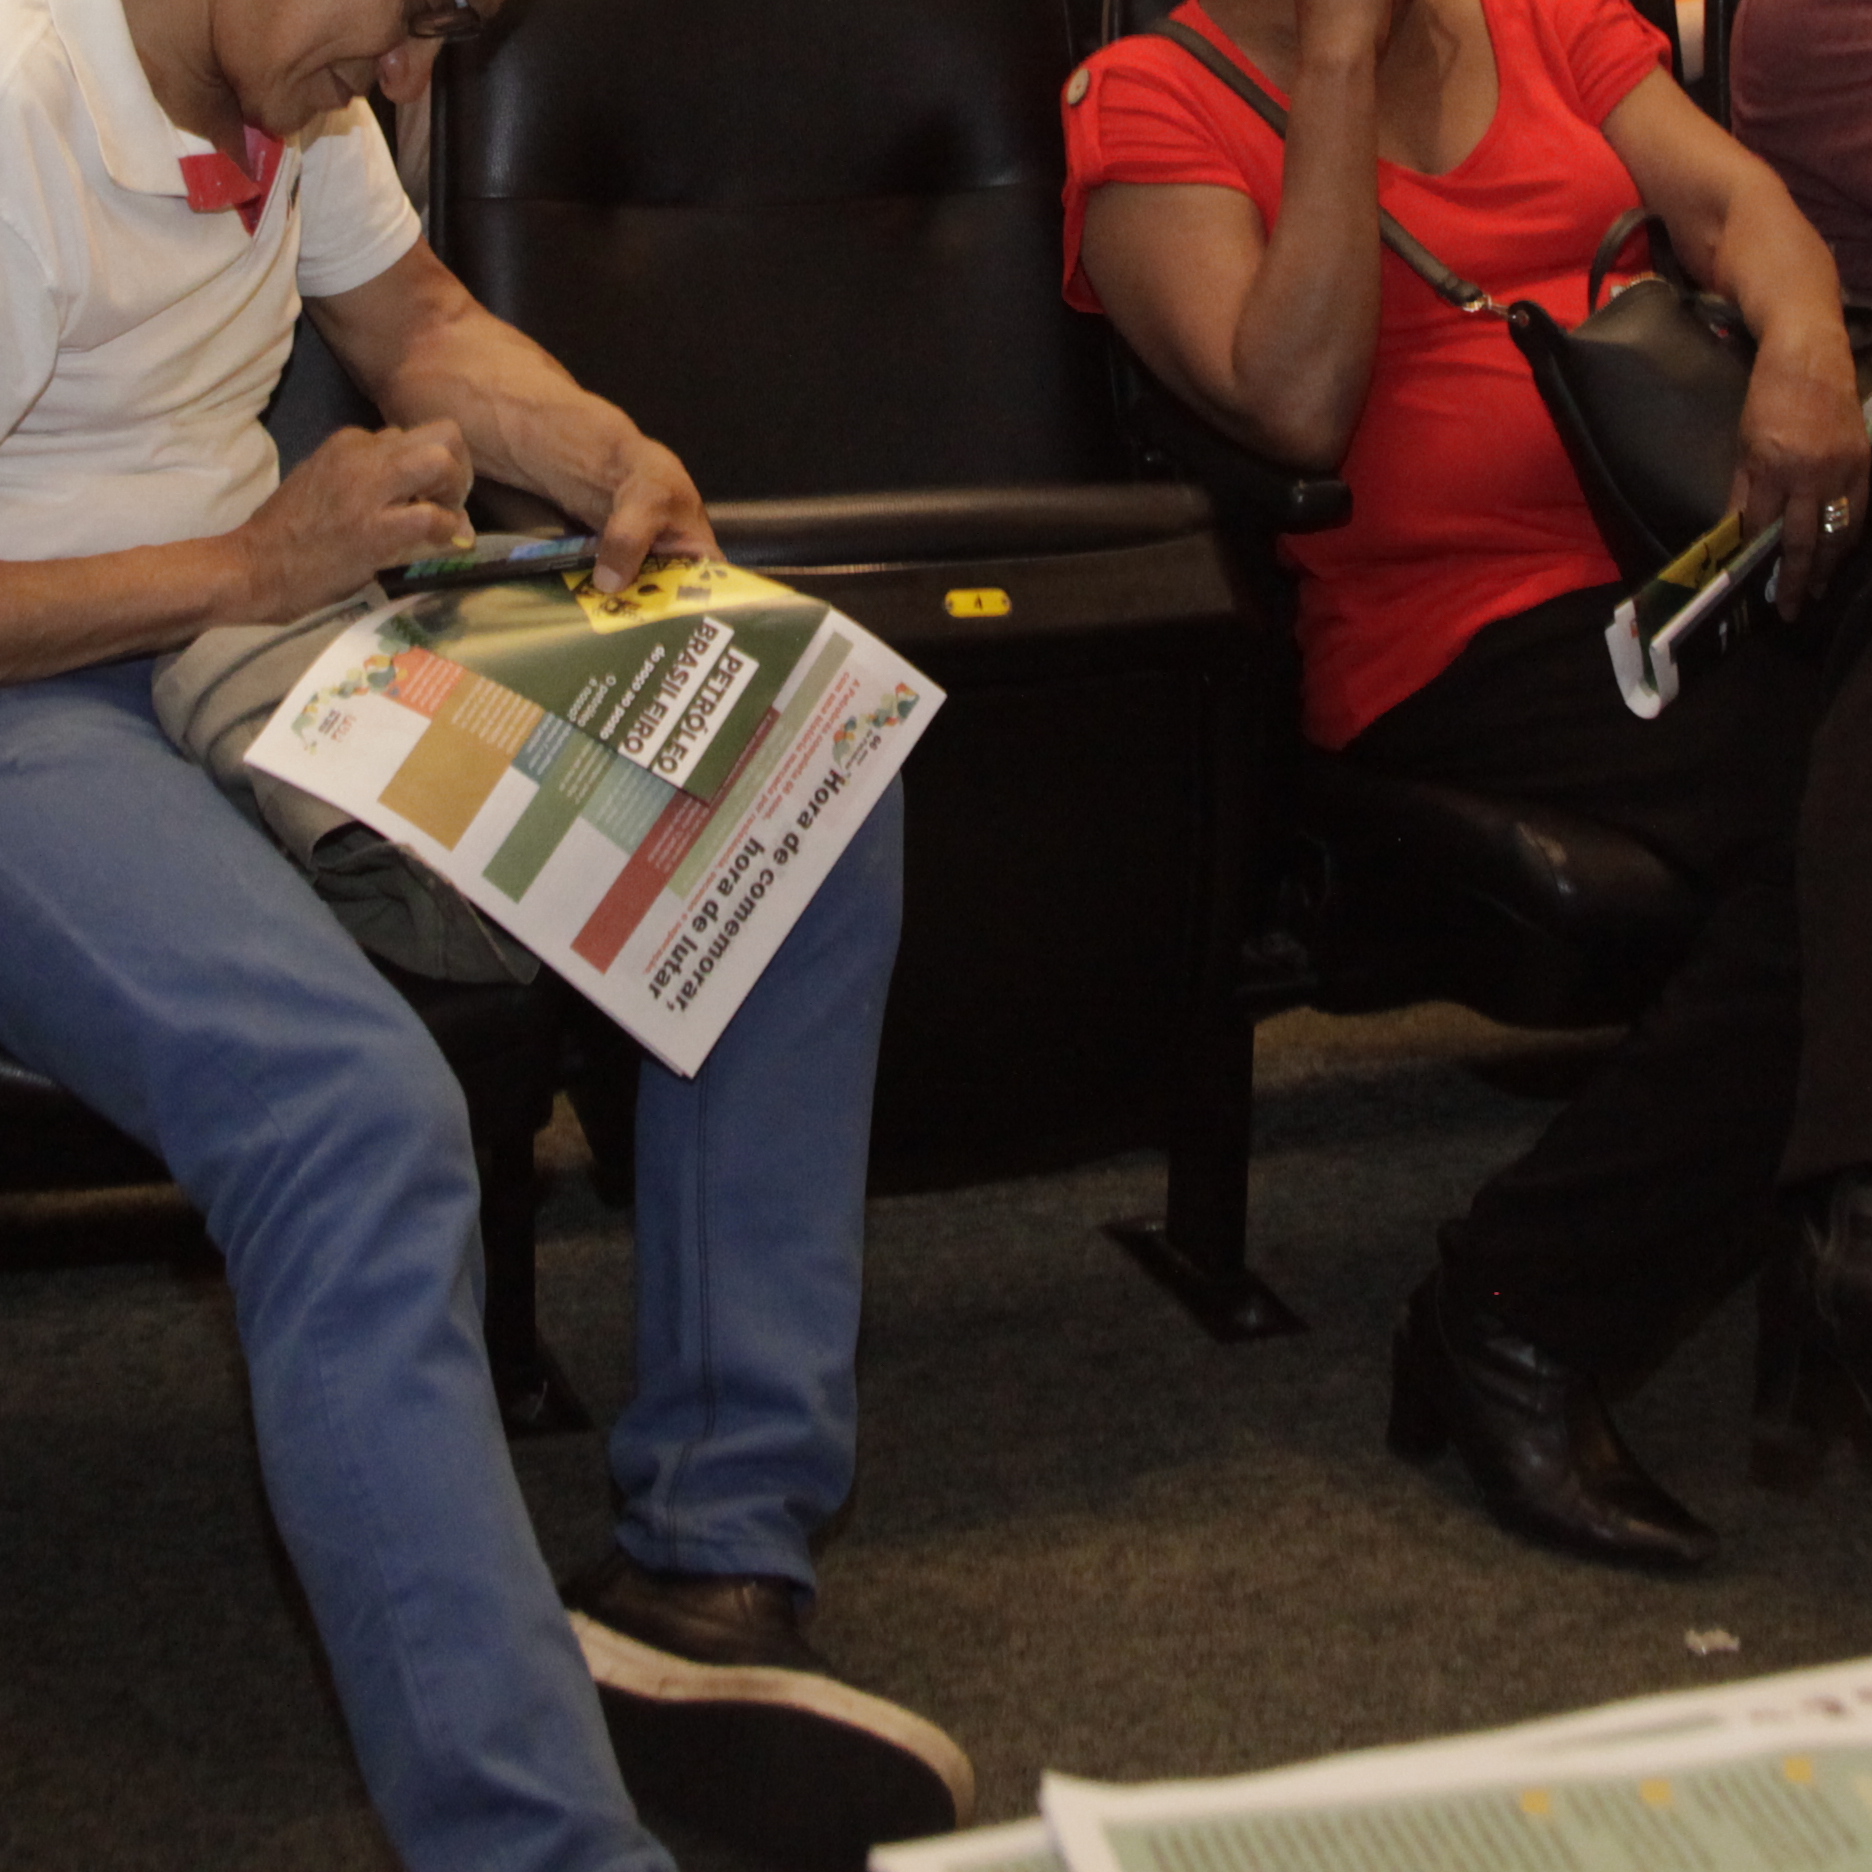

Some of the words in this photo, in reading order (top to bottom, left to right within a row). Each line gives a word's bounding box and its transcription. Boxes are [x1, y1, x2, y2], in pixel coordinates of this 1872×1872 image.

[648, 643, 668, 665] do
[602, 673, 618, 688] O
[618, 618, 720, 758] BRASILEIRO
[627, 659, 655, 692] poço
[564, 684, 594, 723] nosso?
[573, 682, 610, 730] petróleo
[619, 690, 635, 708] ao
[652, 651, 750, 781] PETRÓLEO
[595, 704, 627, 742] posto
[794, 767, 847, 833] Hora
[714, 835, 767, 901] hora
[769, 829, 805, 870] de
[688, 897, 725, 937] de
[663, 861, 778, 1020] comemorar,
[643, 933, 700, 1004] lutar
